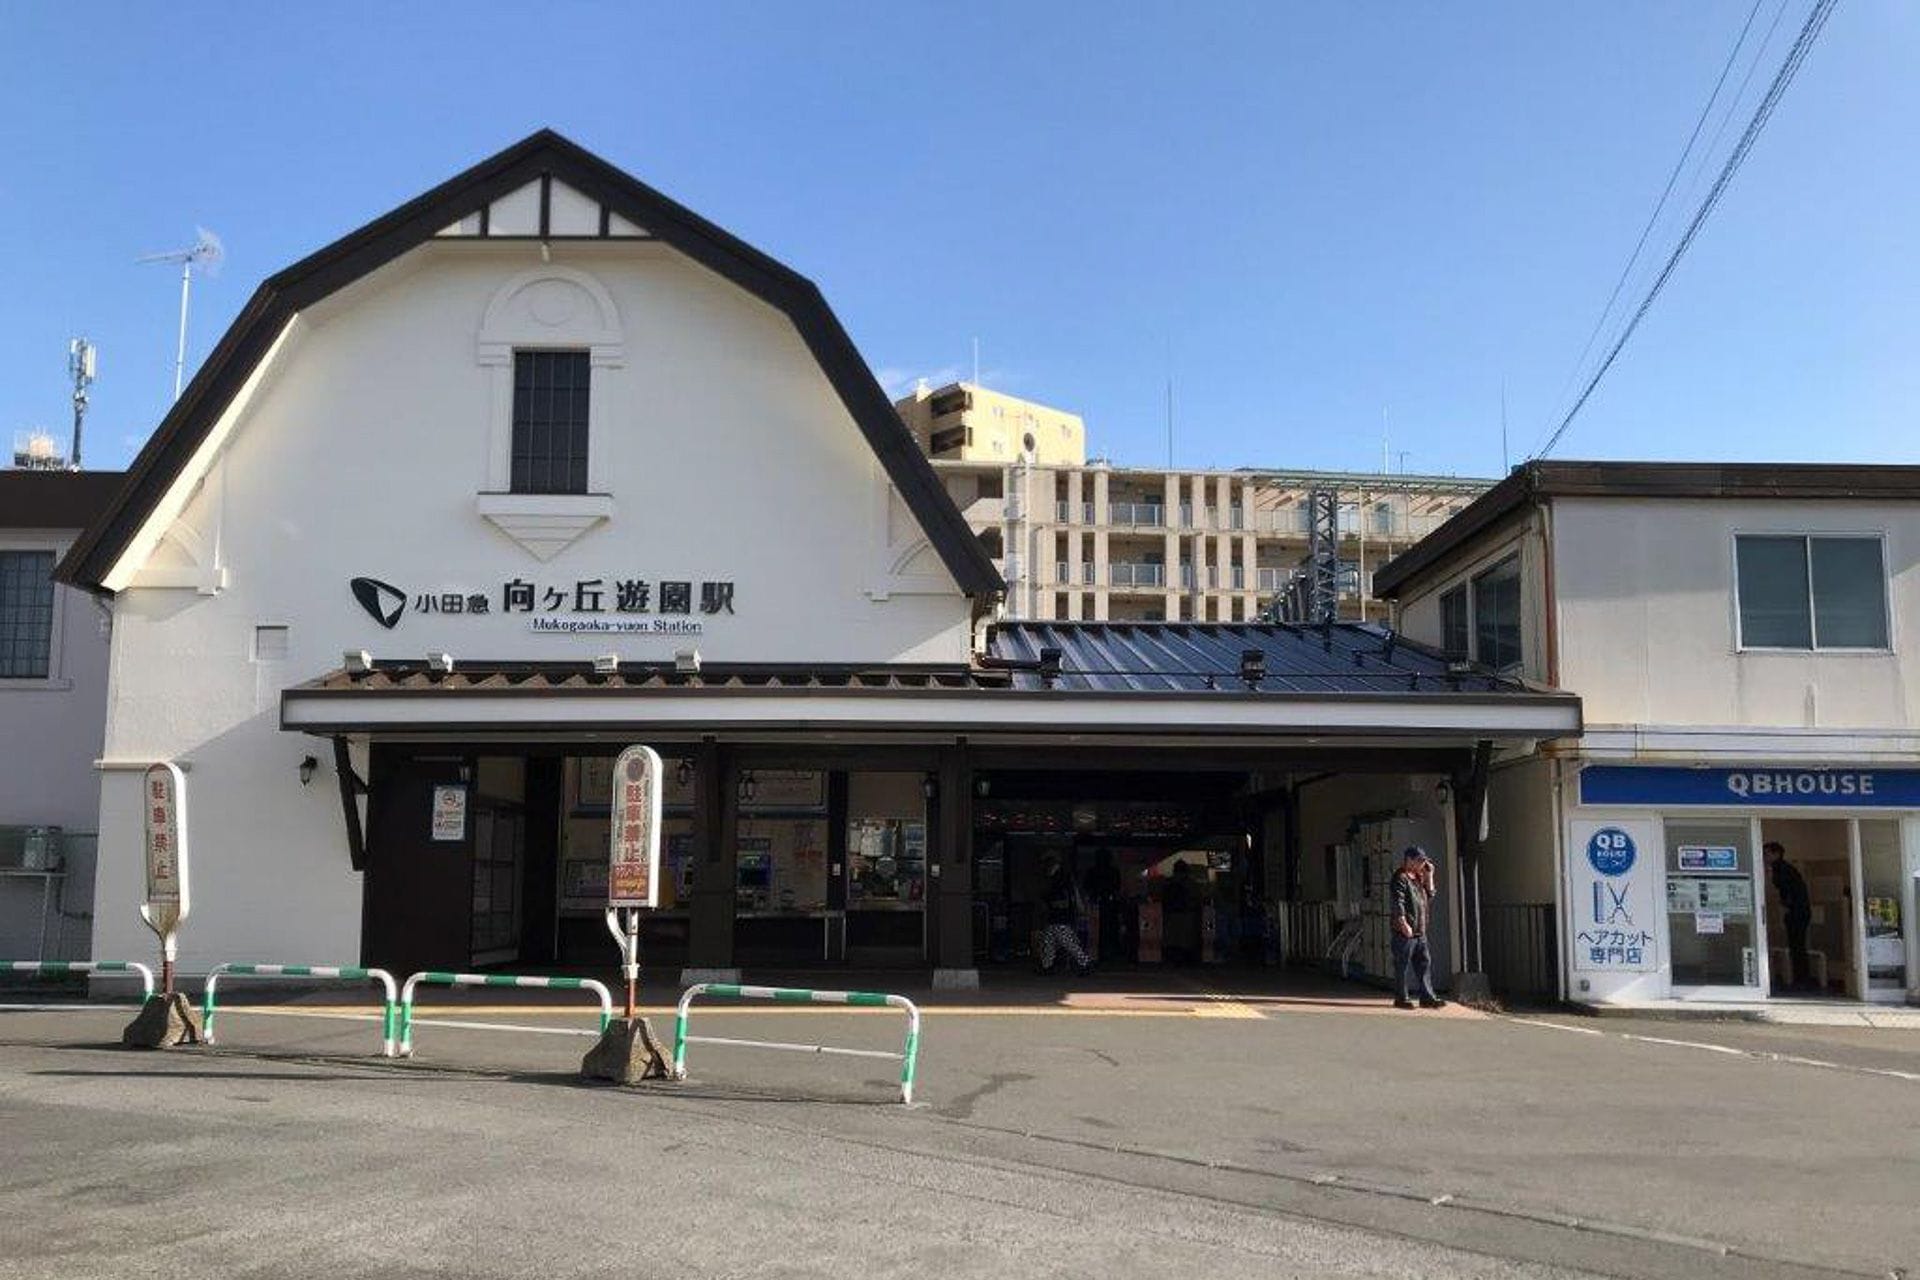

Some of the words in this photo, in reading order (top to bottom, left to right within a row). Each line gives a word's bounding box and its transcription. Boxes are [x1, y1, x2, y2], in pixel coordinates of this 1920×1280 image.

[415, 593, 490, 614] 小田急
[653, 619, 703, 632] Station
[1596, 834, 1627, 850] QB
[1577, 930, 1653, 946] ヘアカット
[1589, 947, 1642, 965] 専門店
